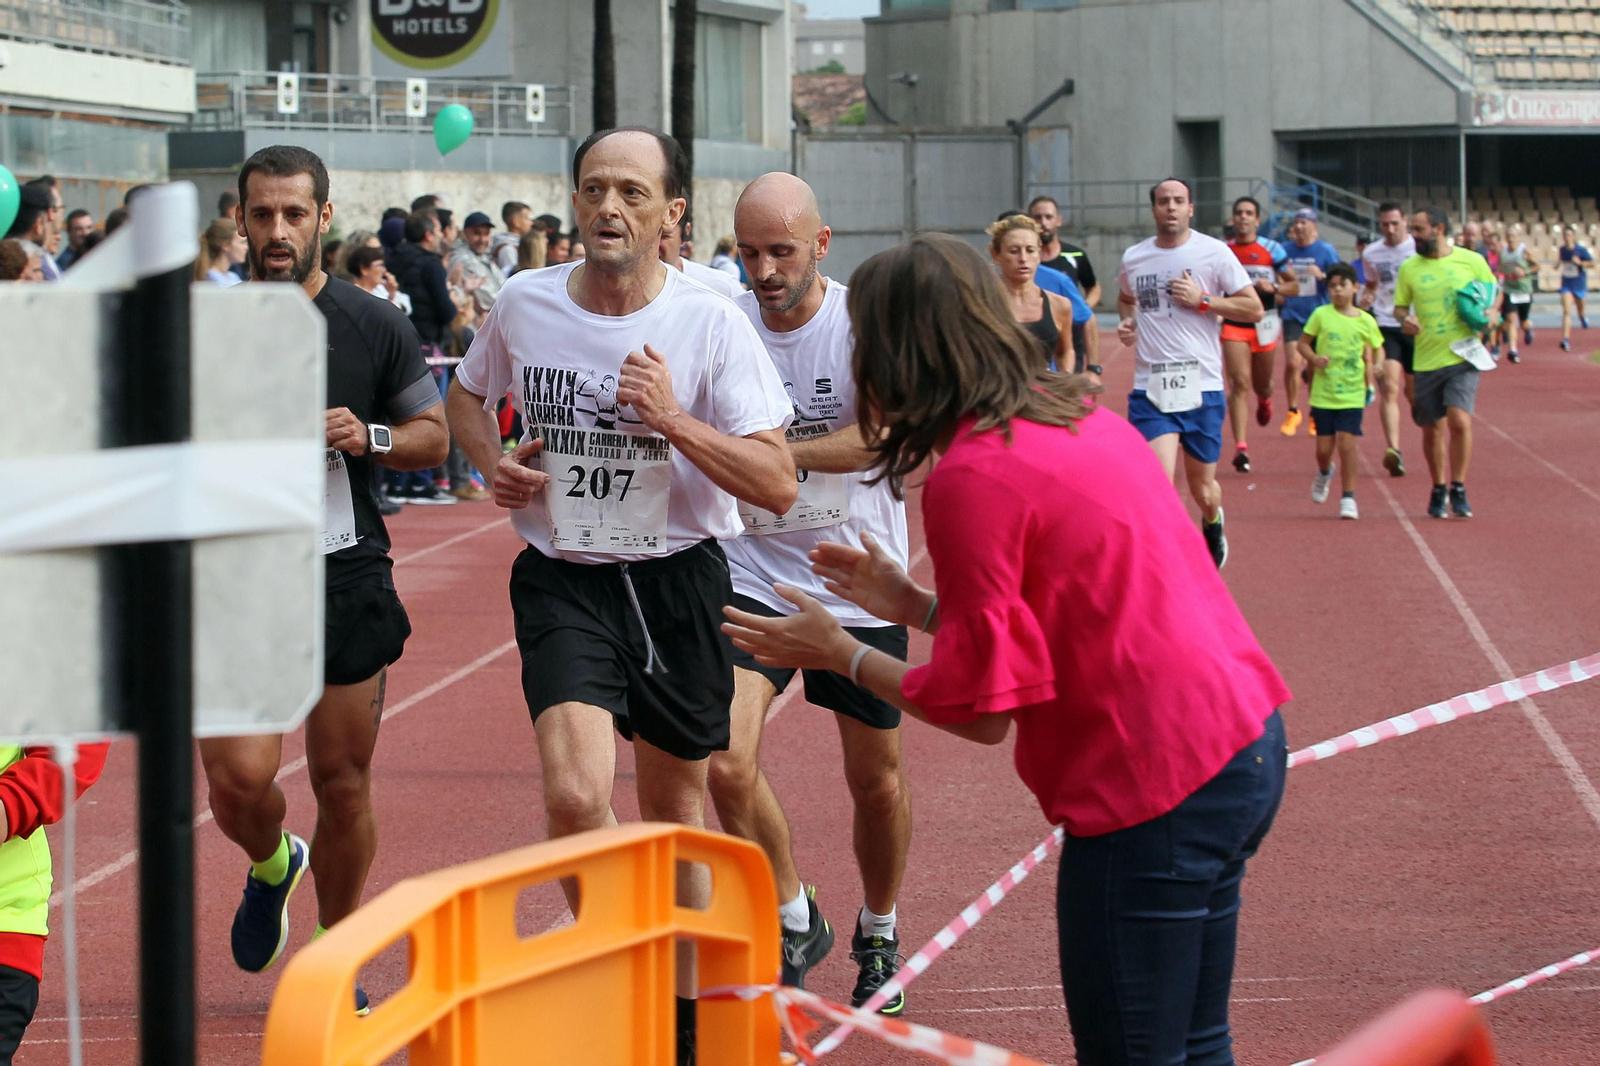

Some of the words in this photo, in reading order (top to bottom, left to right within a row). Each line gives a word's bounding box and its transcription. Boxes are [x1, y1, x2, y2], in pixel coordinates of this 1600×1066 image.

[392, 18, 468, 35] HOTELS
[523, 366, 578, 407] XXXIX
[1162, 375, 1187, 390] 162
[524, 402, 575, 427] CARRERA
[809, 402, 842, 410] AUTOMOCIÓN
[795, 423, 829, 437] POPULAR
[540, 426, 586, 457] XXXIX
[589, 432, 628, 449] CARRERA
[631, 435, 670, 451] POPULAR
[588, 446, 621, 460] CIUDAD
[626, 449, 637, 461] DE
[642, 450, 669, 462] JEREZ
[565, 465, 636, 502] 207
